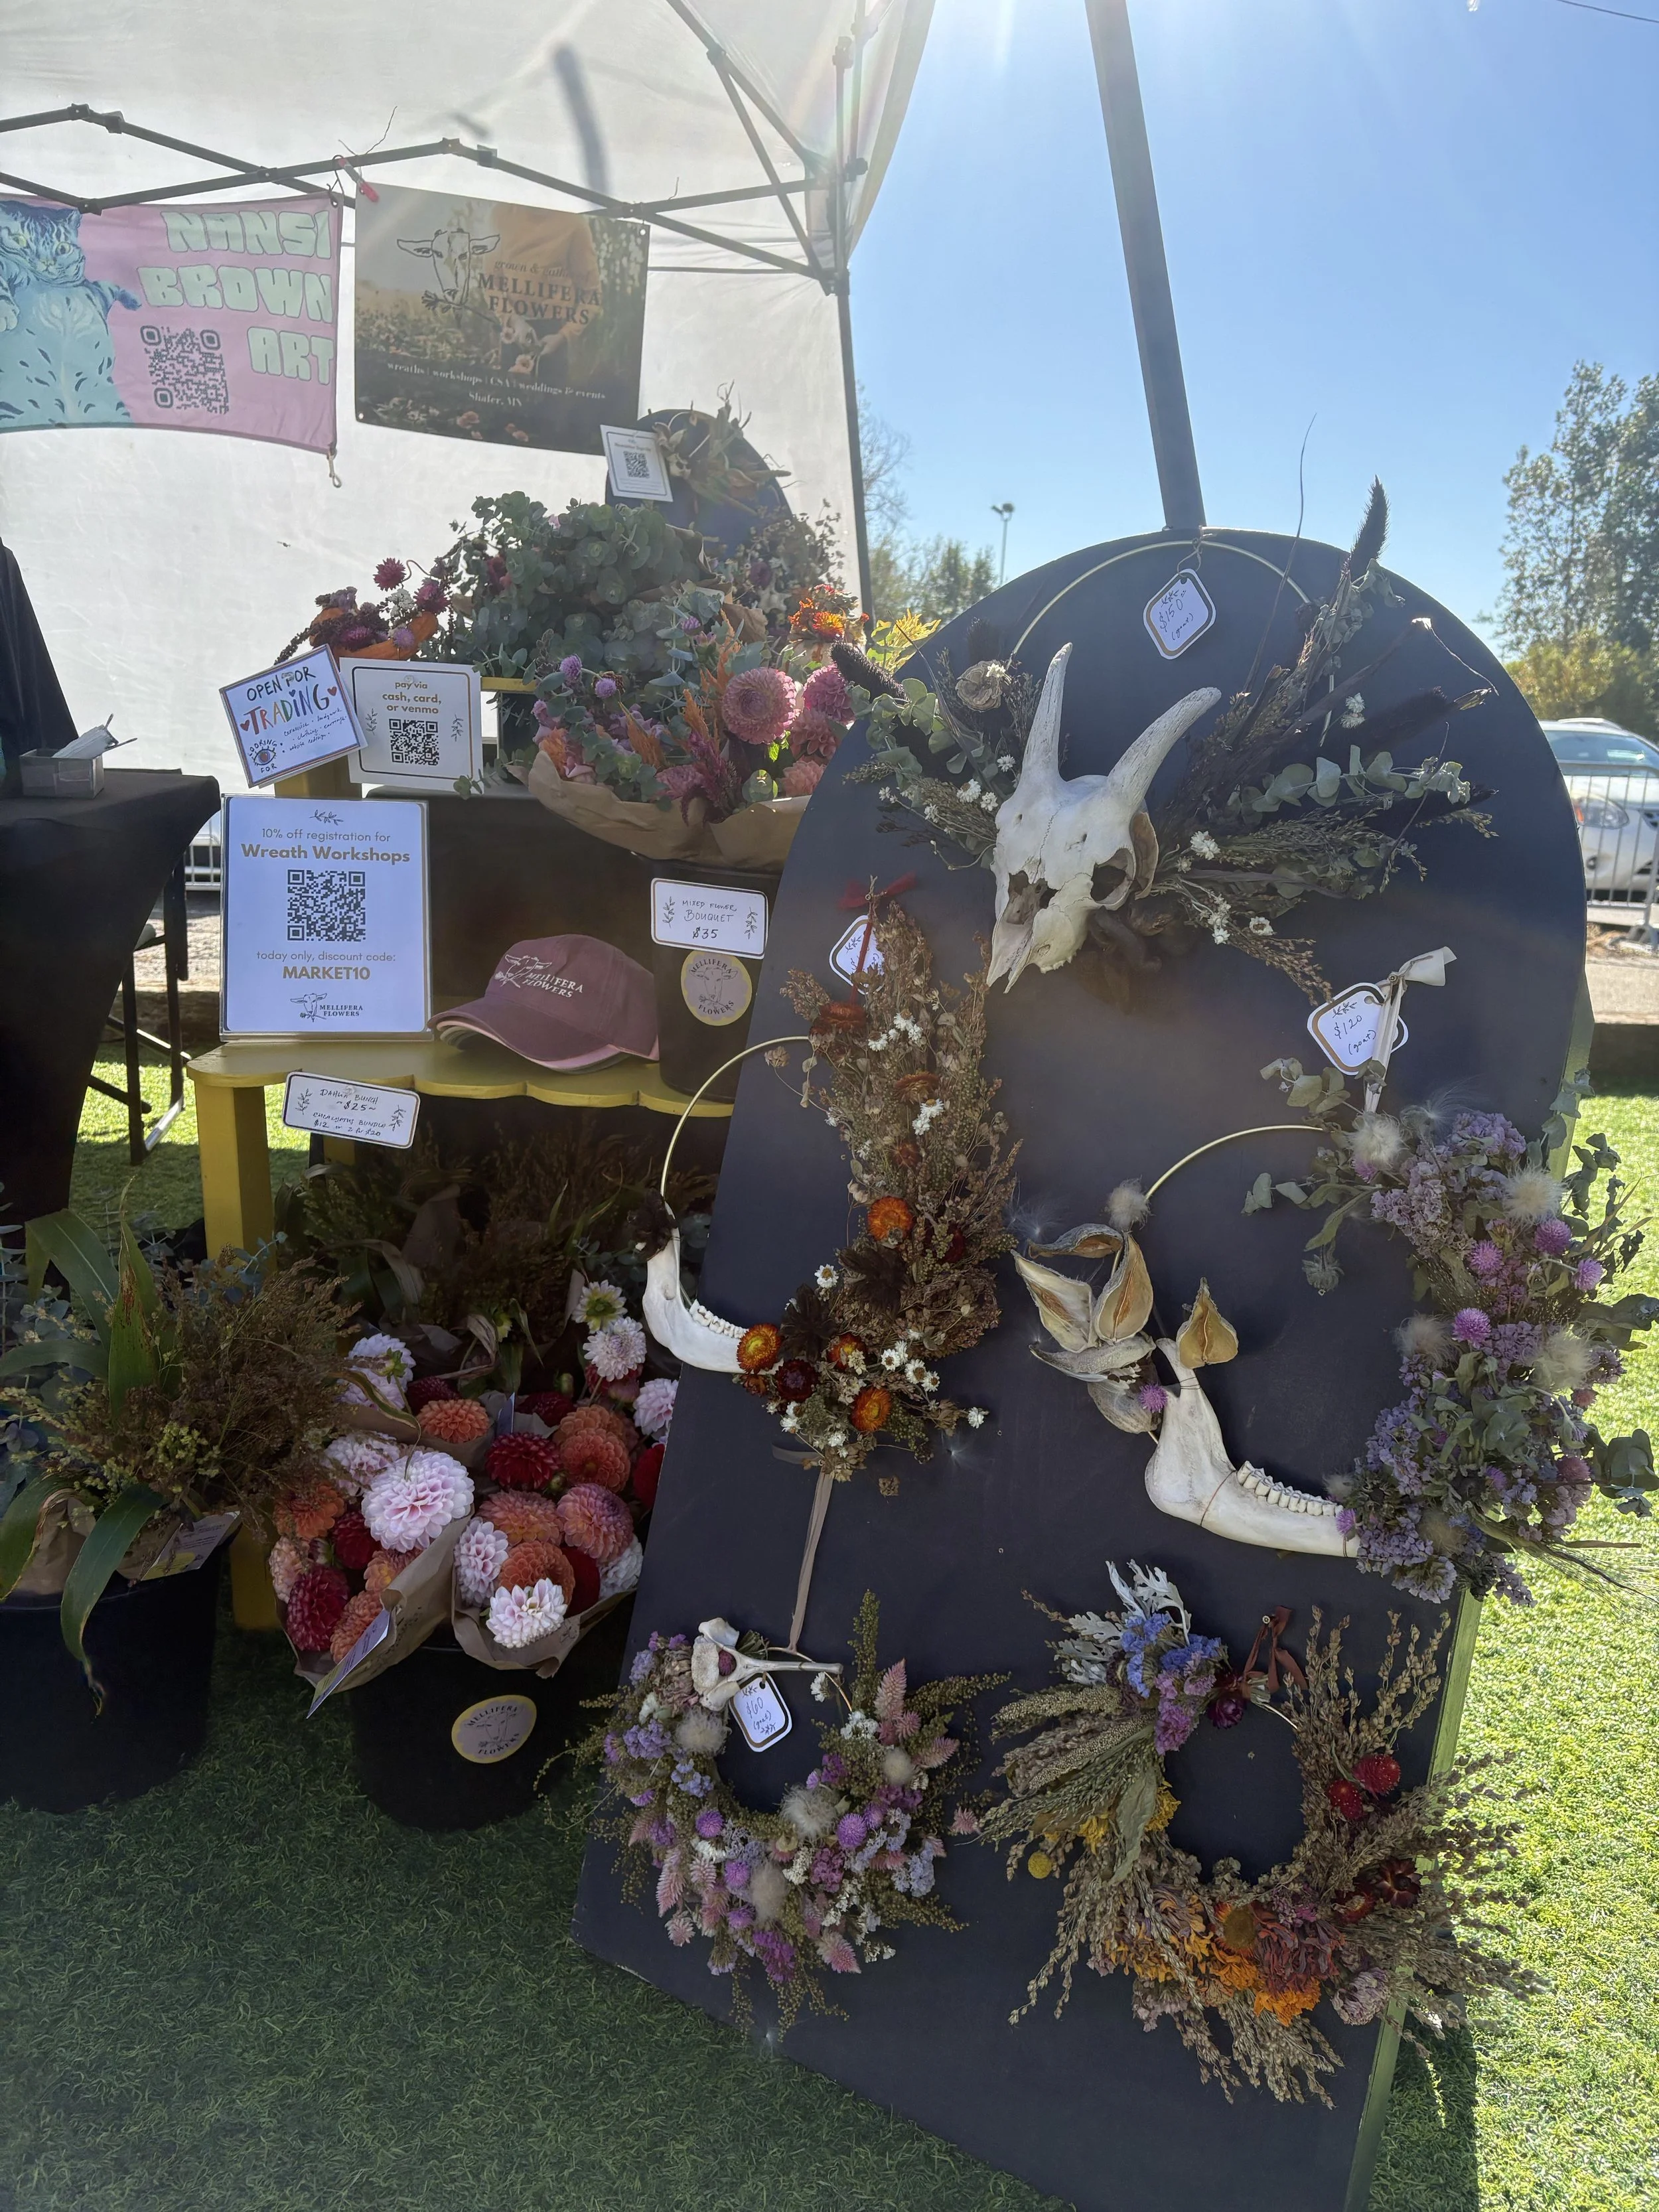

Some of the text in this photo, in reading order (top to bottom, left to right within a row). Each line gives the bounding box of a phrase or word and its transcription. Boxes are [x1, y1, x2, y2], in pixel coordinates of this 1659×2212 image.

[161, 211, 331, 259] NANSI
[495, 260, 526, 273] grown
[530, 263, 540, 274] &
[137, 264, 332, 324] BROWN
[478, 273, 601, 305] MELLIFERA
[489, 295, 589, 325] FLOWERS
[248, 327, 334, 385] ART
[388, 363, 425, 374] wreaths
[433, 370, 482, 386] workshops
[490, 376, 510, 388] CSA
[519, 382, 562, 395] weddings
[575, 390, 606, 400] events
[1159, 599, 1183, 632] $150
[247, 666, 316, 701] OPEN FOR
[382, 692, 441, 705] cash, card,
[249, 739, 277, 757] LOOKING
[261, 763, 277, 773] FOR
[262, 828, 390, 843] 10% off registration for
[241, 843, 410, 865] Wreath Workshops
[684, 909, 734, 922] BOUQUET
[709, 903, 737, 912] FLOWER
[692, 926, 719, 940] $35
[257, 951, 396, 962] today only, discount code:
[282, 966, 371, 980] MARKET10
[690, 959, 733, 974] MELLIFERA
[522, 979, 573, 997] FLOWERS
[526, 972, 583, 994] MELLIFERA
[698, 1000, 734, 1015] FLOWERS
[1334, 1015, 1362, 1039] $120
[1348, 1029, 1376, 1055] (goat)
[355, 1094, 378, 1104] BUNCH
[314, 1119, 329, 1128] $12
[366, 1128, 381, 1136] $20
[746, 1697, 763, 1718] $60
[754, 1710, 771, 1730] (goat)
